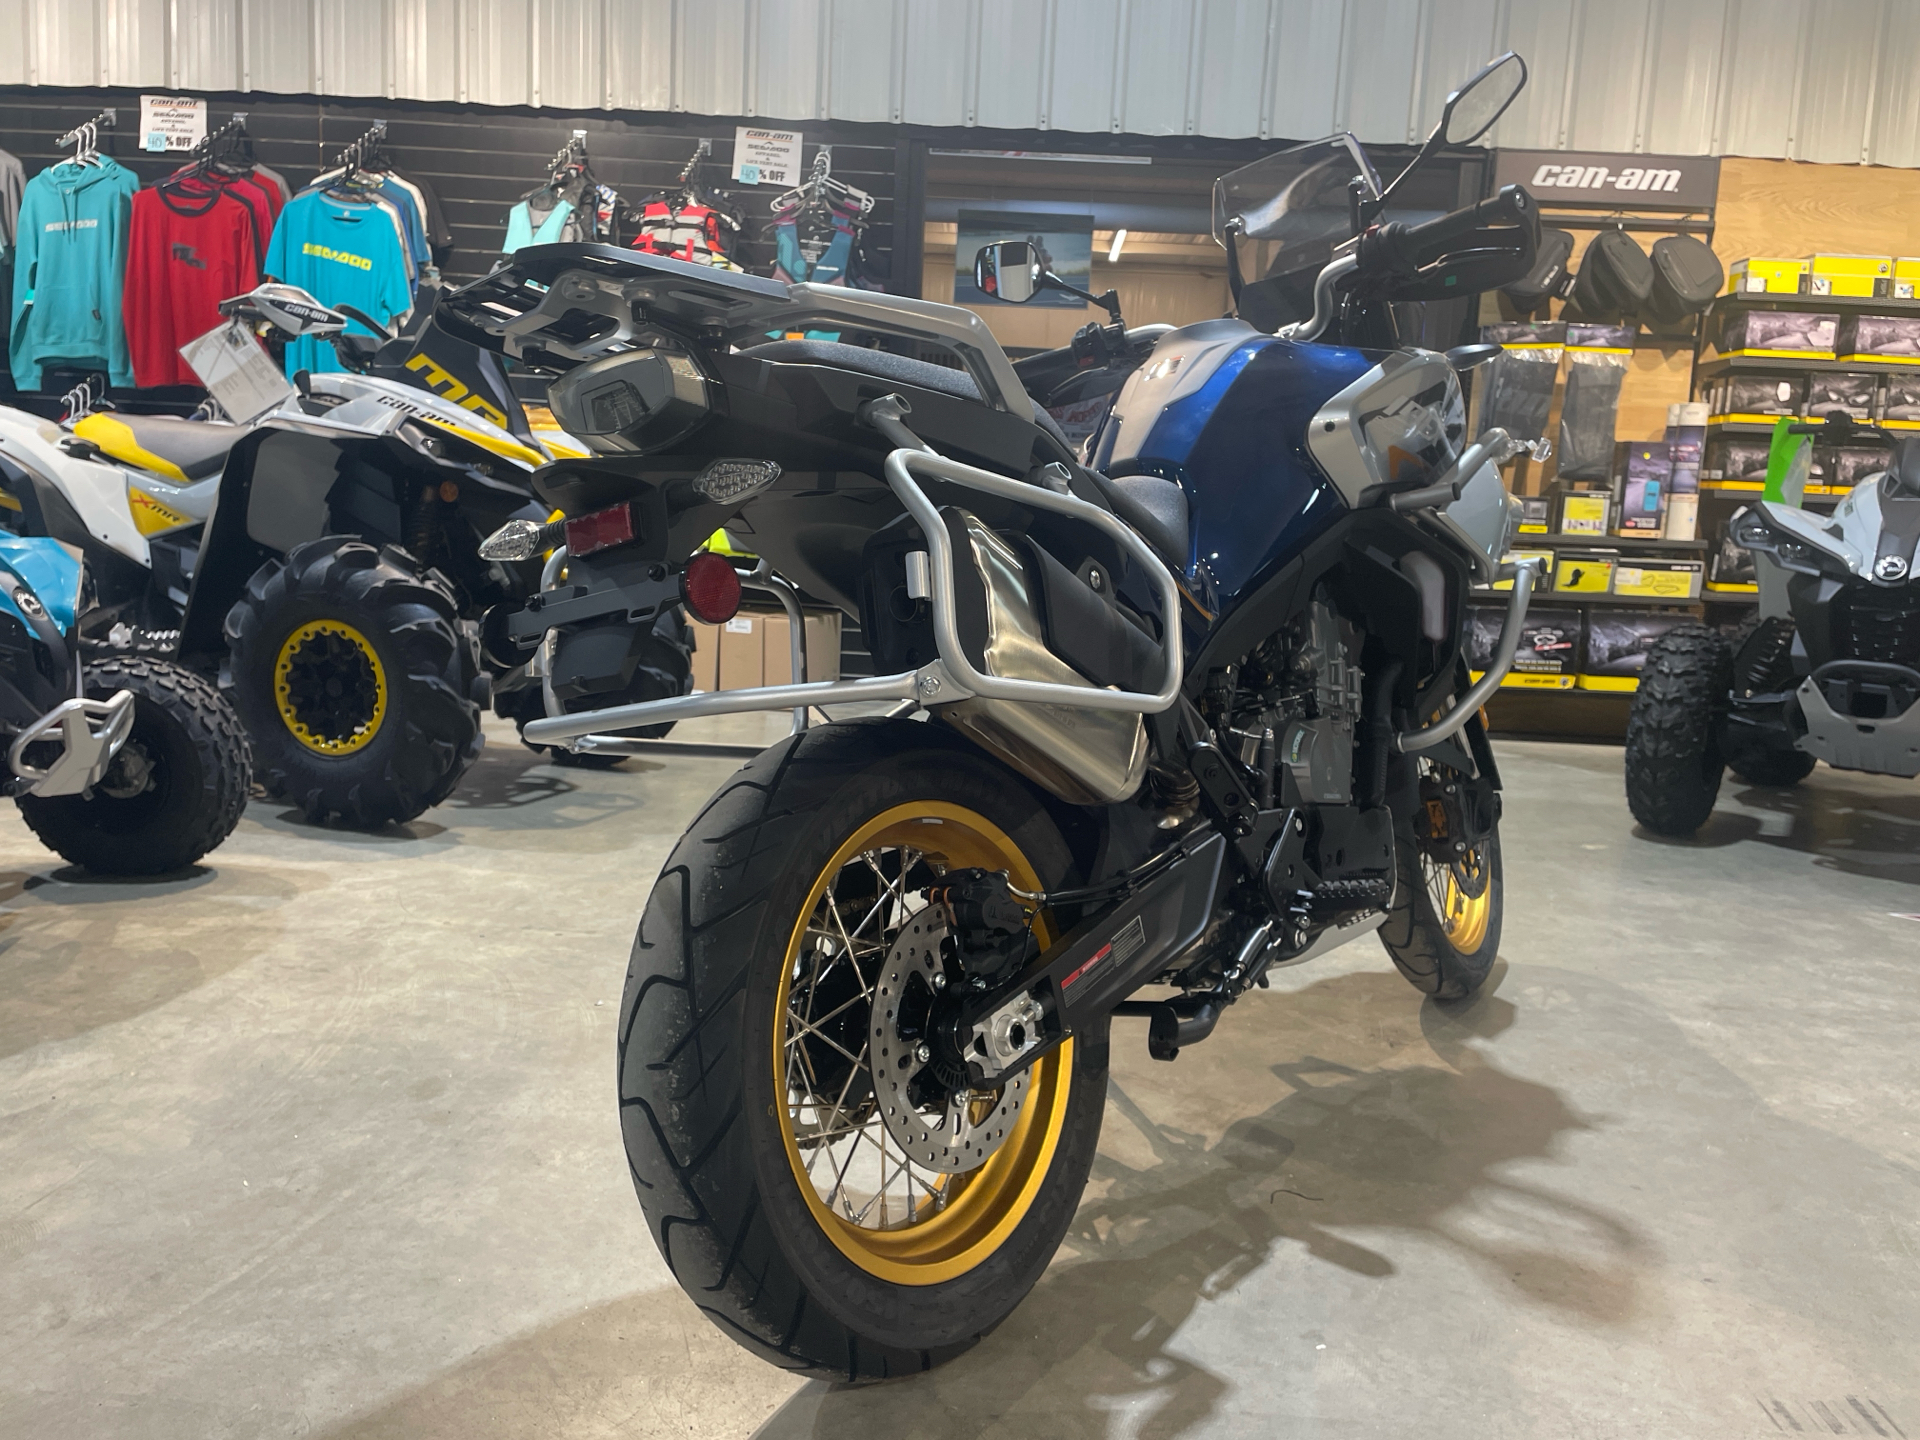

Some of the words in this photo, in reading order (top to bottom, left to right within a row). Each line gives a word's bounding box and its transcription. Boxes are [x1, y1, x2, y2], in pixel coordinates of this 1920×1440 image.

[746, 130, 793, 140] can-am
[175, 136, 193, 147] OFF
[769, 170, 786, 182] OFF
[1531, 164, 1682, 192] can-am
[284, 303, 330, 322] can-am
